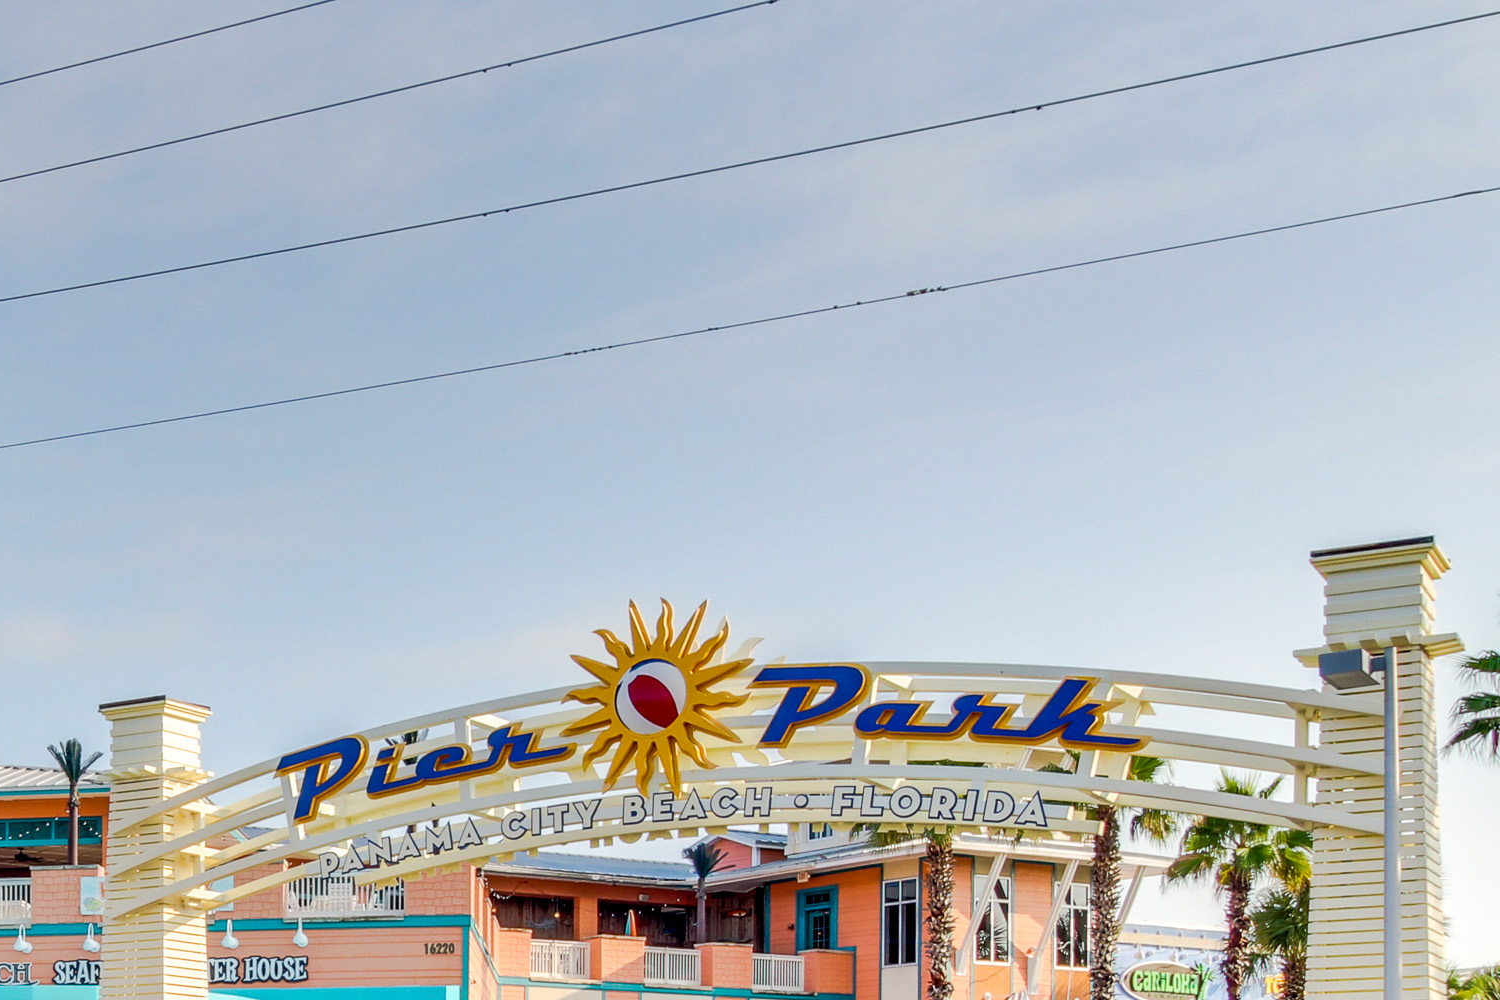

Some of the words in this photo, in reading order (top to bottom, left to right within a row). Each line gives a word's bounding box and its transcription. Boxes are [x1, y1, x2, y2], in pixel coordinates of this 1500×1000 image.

[273, 722, 577, 826] Pier
[748, 663, 1151, 751] Park
[319, 817, 482, 878] PANAMA
[501, 799, 601, 840] CITY
[623, 787, 773, 825] BEACH
[830, 785, 1048, 827] FLORIDA
[53, 959, 101, 985] SEAF
[242, 955, 309, 984] HOUSE
[424, 943, 455, 954] 16220
